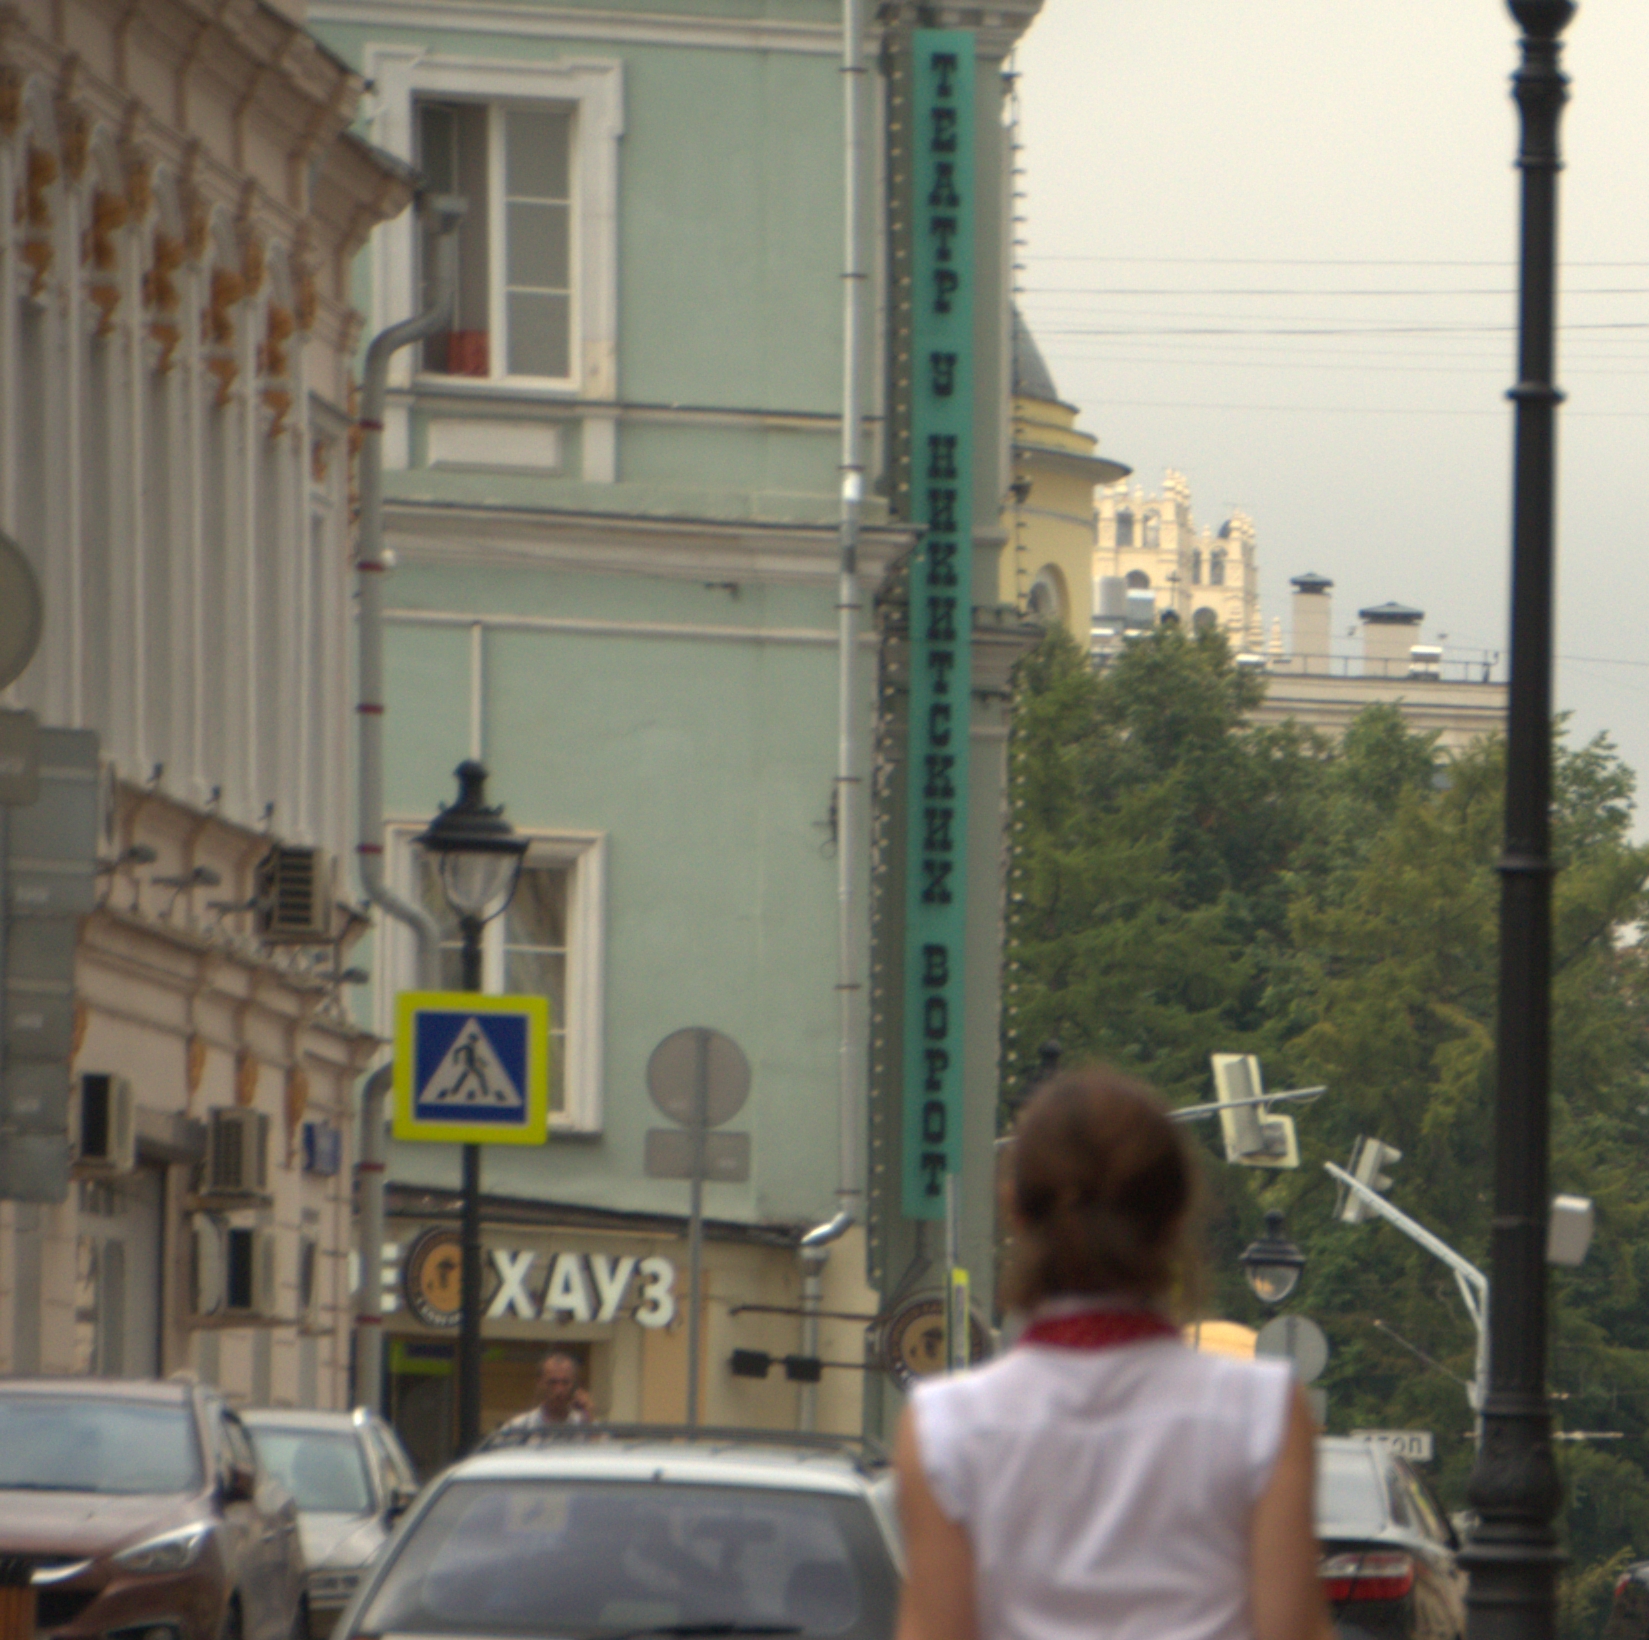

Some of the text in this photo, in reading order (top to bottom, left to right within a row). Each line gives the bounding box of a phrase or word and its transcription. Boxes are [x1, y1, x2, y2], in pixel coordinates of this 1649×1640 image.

[921, 52, 960, 1198] ТЕАТР У НИКИТСКИХ ВОРОТ
[485, 1248, 676, 1330] ХАУЗ
